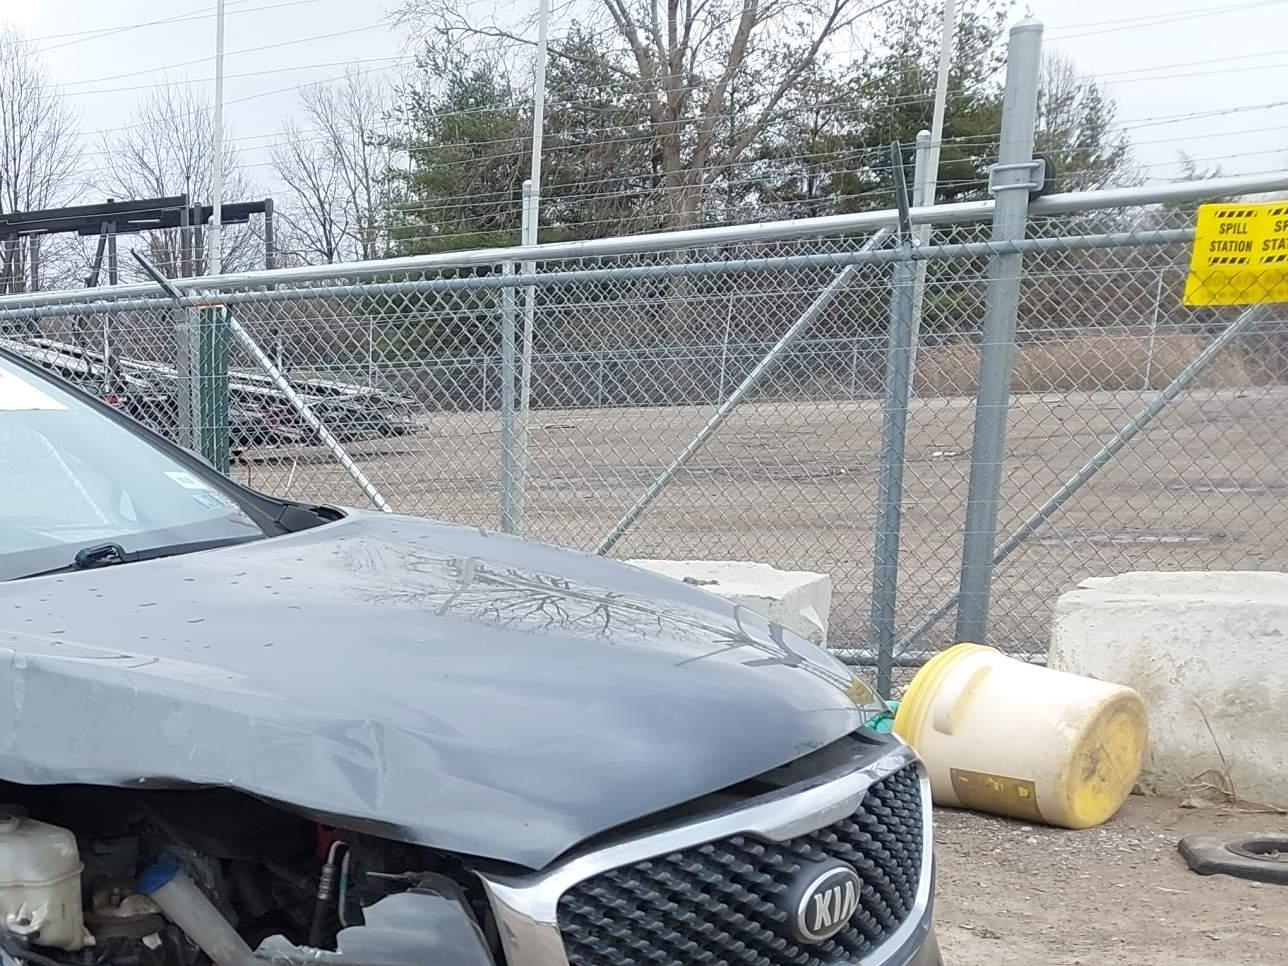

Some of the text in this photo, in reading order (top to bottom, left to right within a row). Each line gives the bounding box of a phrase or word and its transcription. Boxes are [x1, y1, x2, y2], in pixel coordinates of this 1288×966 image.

[1219, 223, 1248, 235] SPILL
[1209, 240, 1253, 252] STATION
[813, 880, 855, 931] KIA
